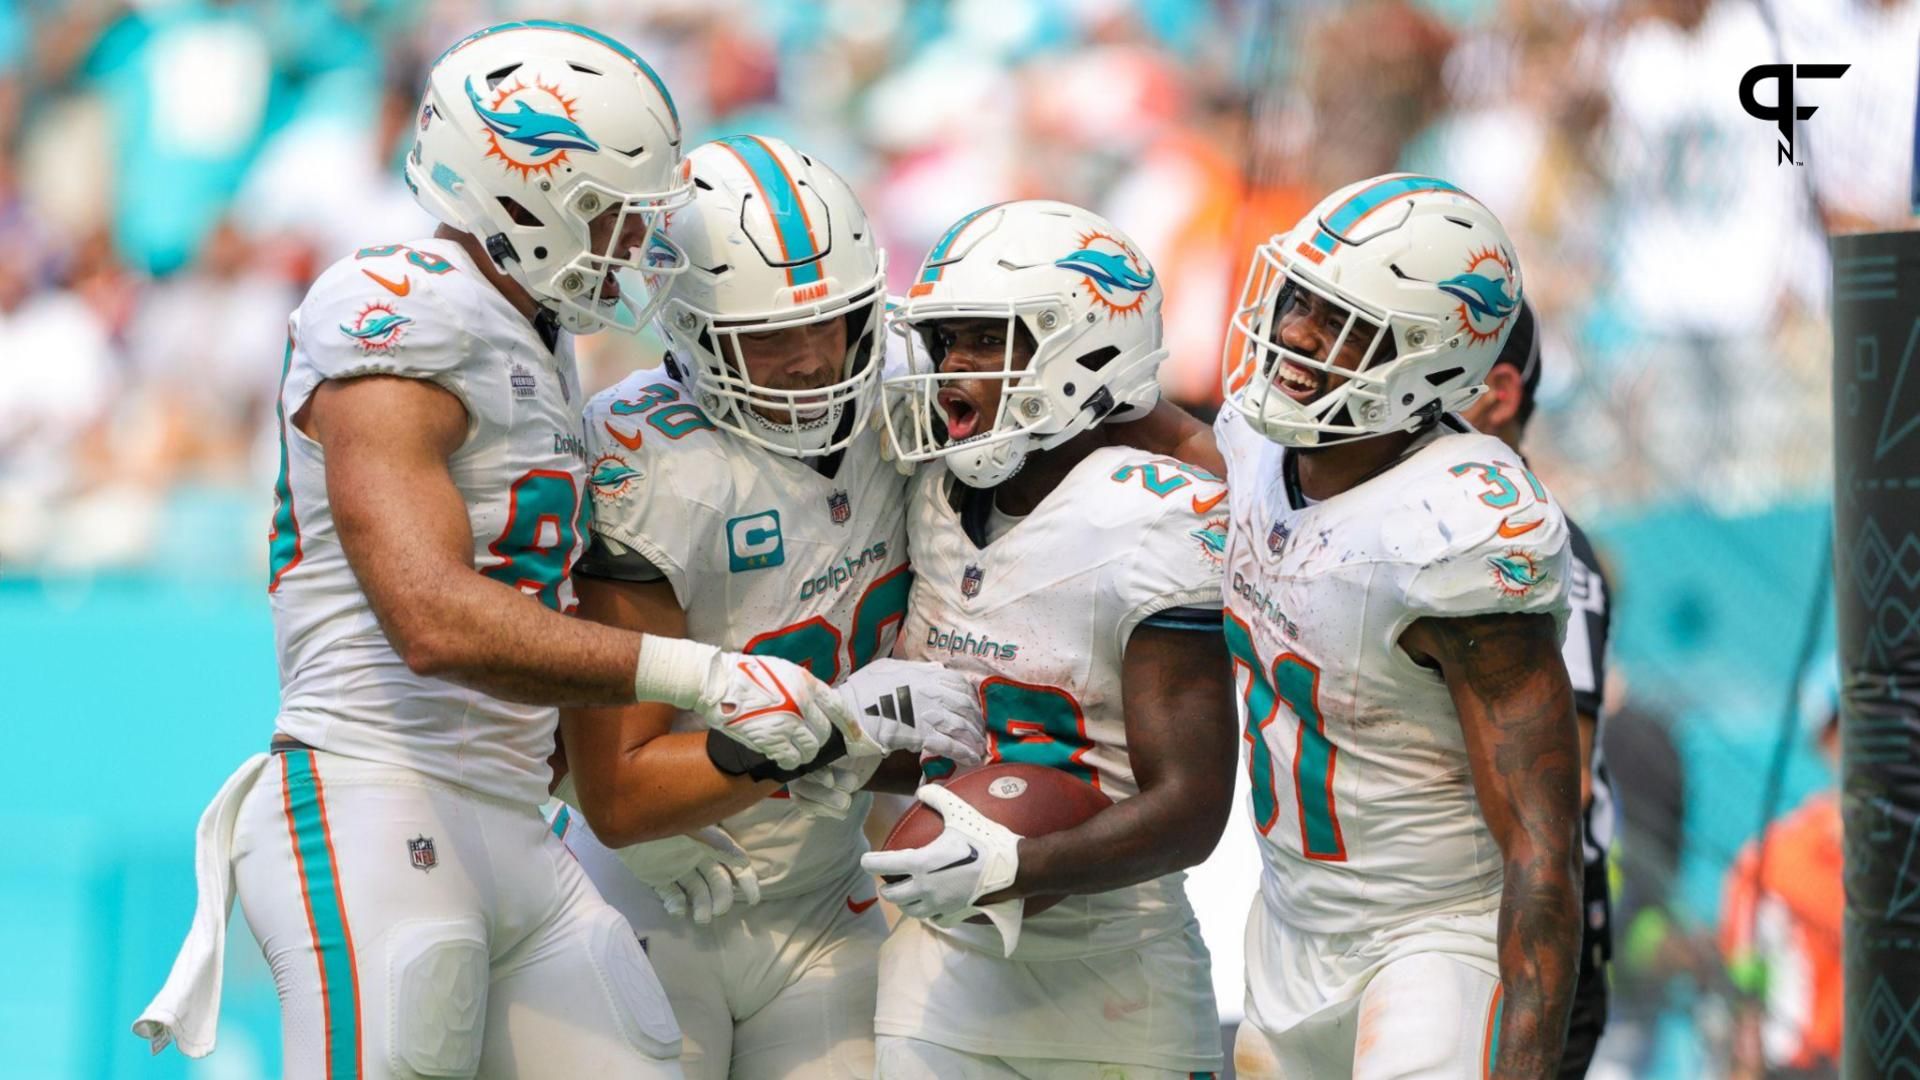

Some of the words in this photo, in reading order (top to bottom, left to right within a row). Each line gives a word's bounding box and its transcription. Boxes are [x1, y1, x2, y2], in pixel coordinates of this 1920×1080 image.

[792, 283, 828, 304] MIAMI
[610, 383, 718, 440] 30
[1448, 461, 1548, 509] 31
[733, 514, 780, 559] C
[800, 540, 889, 602] Dolphins
[1233, 571, 1299, 641] Dolphins
[926, 626, 1019, 660] Dolphins
